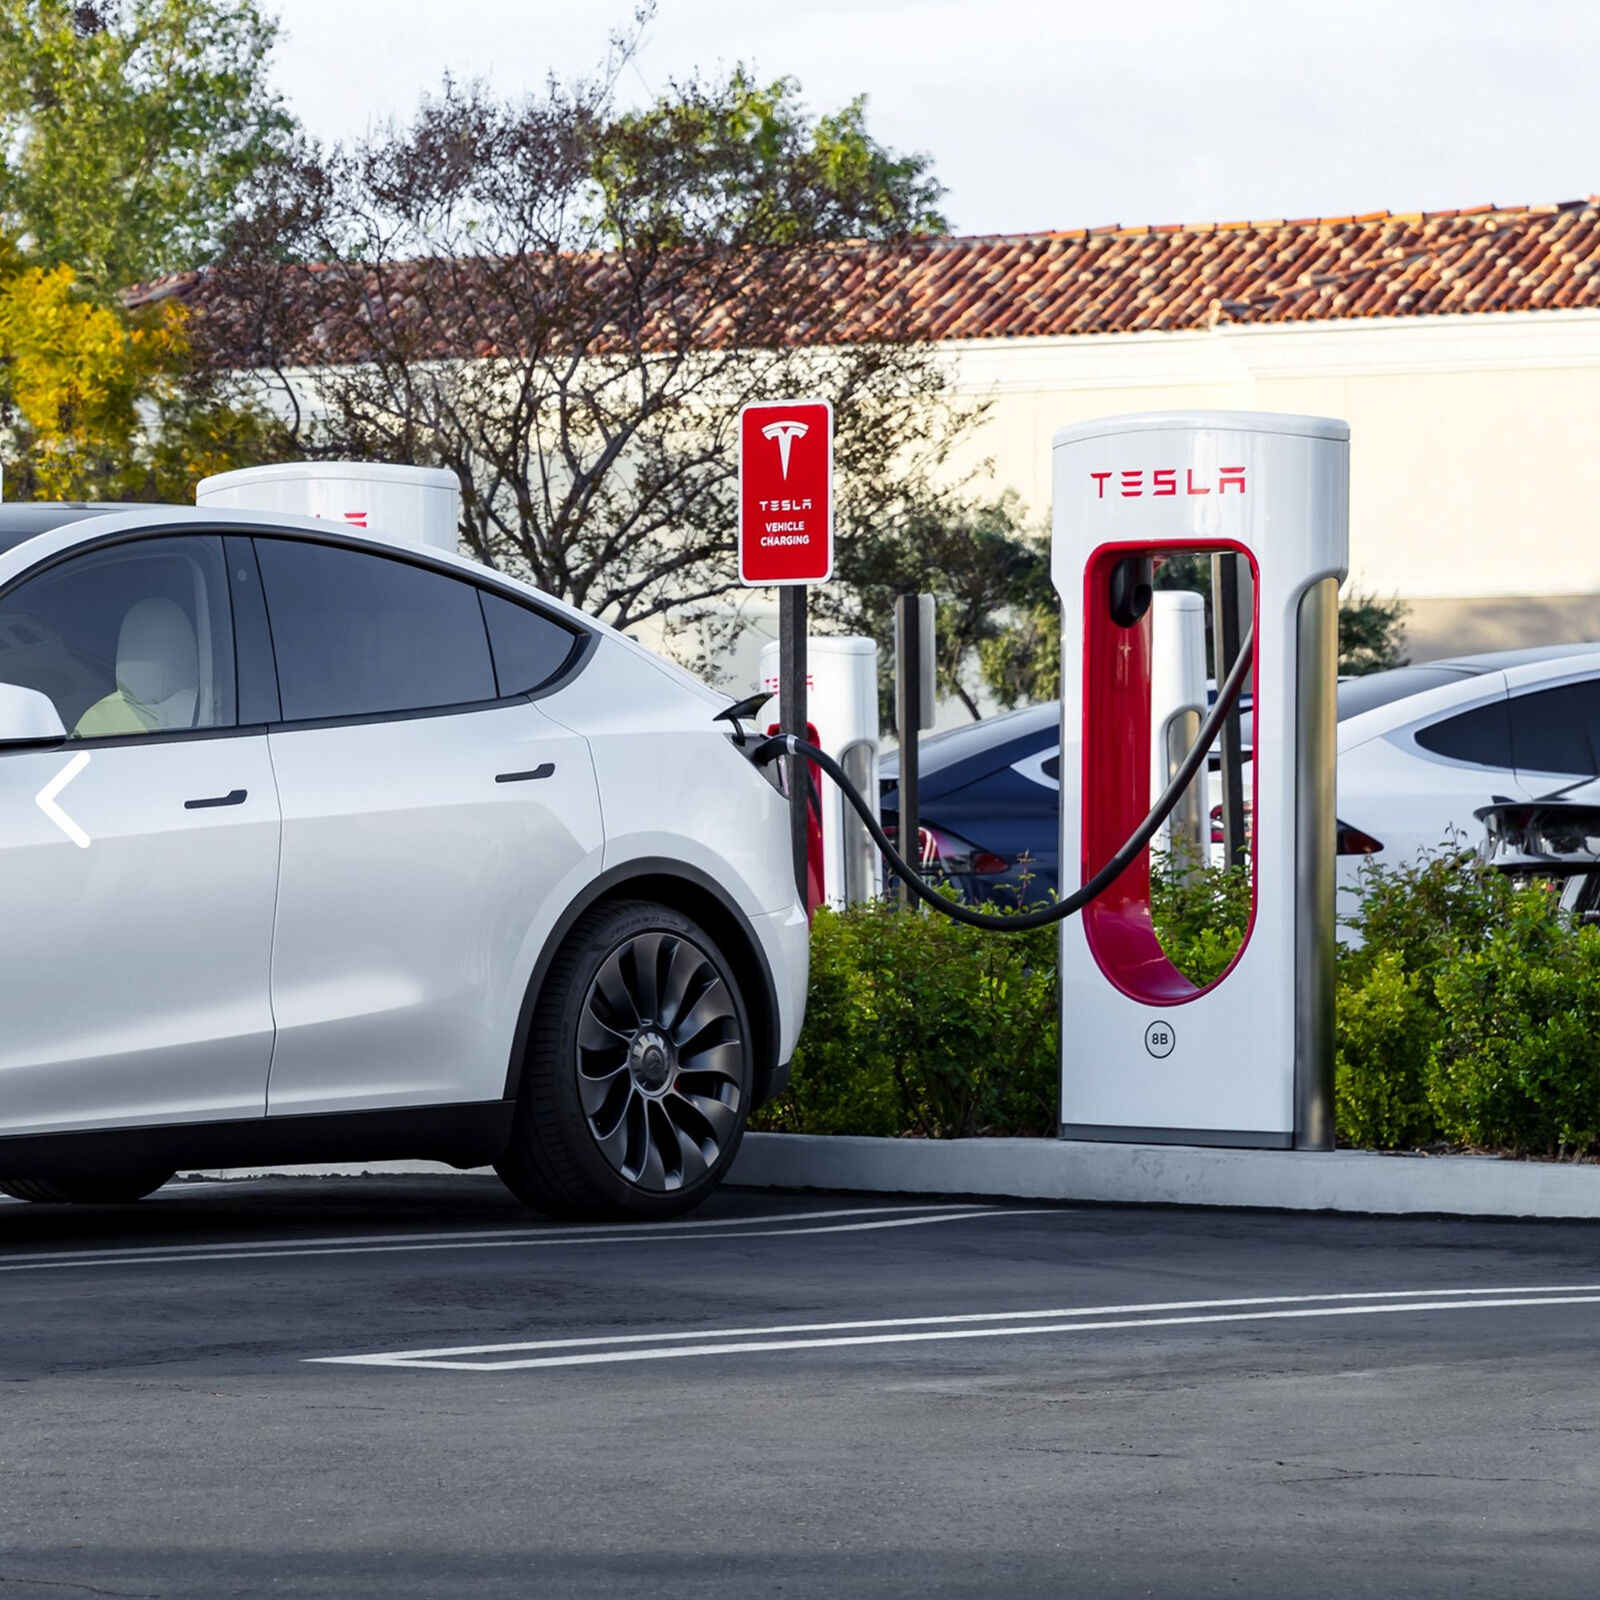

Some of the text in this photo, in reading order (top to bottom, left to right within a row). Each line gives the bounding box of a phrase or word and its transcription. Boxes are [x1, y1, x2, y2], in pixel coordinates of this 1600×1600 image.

[1090, 467, 1246, 498] TESLA
[759, 498, 812, 511] TESLA
[765, 521, 805, 532] VEHICLE
[760, 535, 810, 547] CHARGING
[1151, 1033, 1169, 1045] 8B
